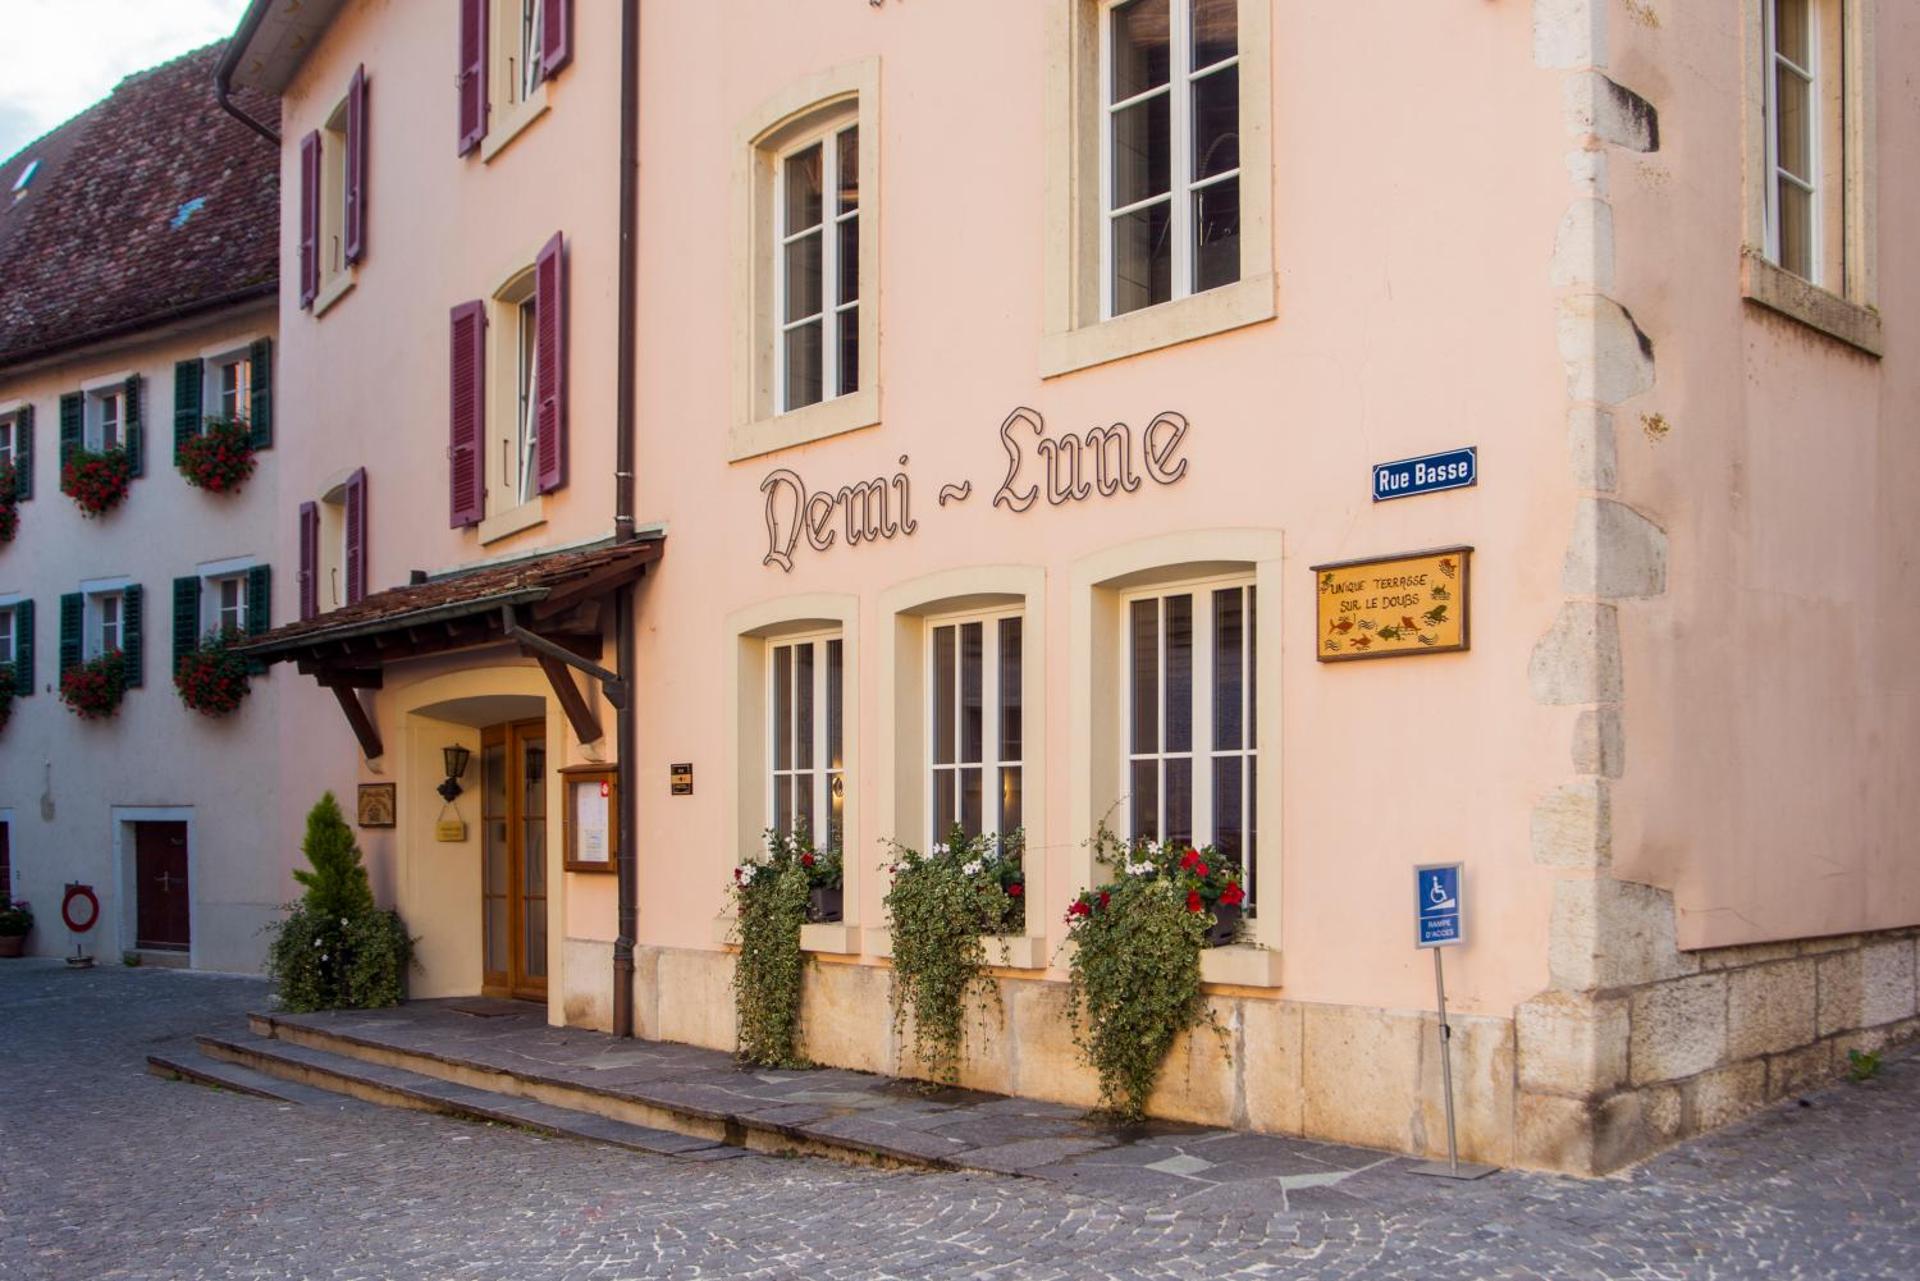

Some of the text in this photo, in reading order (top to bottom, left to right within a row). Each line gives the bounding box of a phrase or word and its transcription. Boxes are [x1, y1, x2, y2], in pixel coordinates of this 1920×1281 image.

[760, 455, 917, 573] Demi
[993, 406, 1190, 513] Lune
[1379, 461, 1468, 492] Rue Basse
[1330, 574, 1429, 595] UNIQUE TERRASSE
[1340, 593, 1421, 613] SUR LE DOUBS
